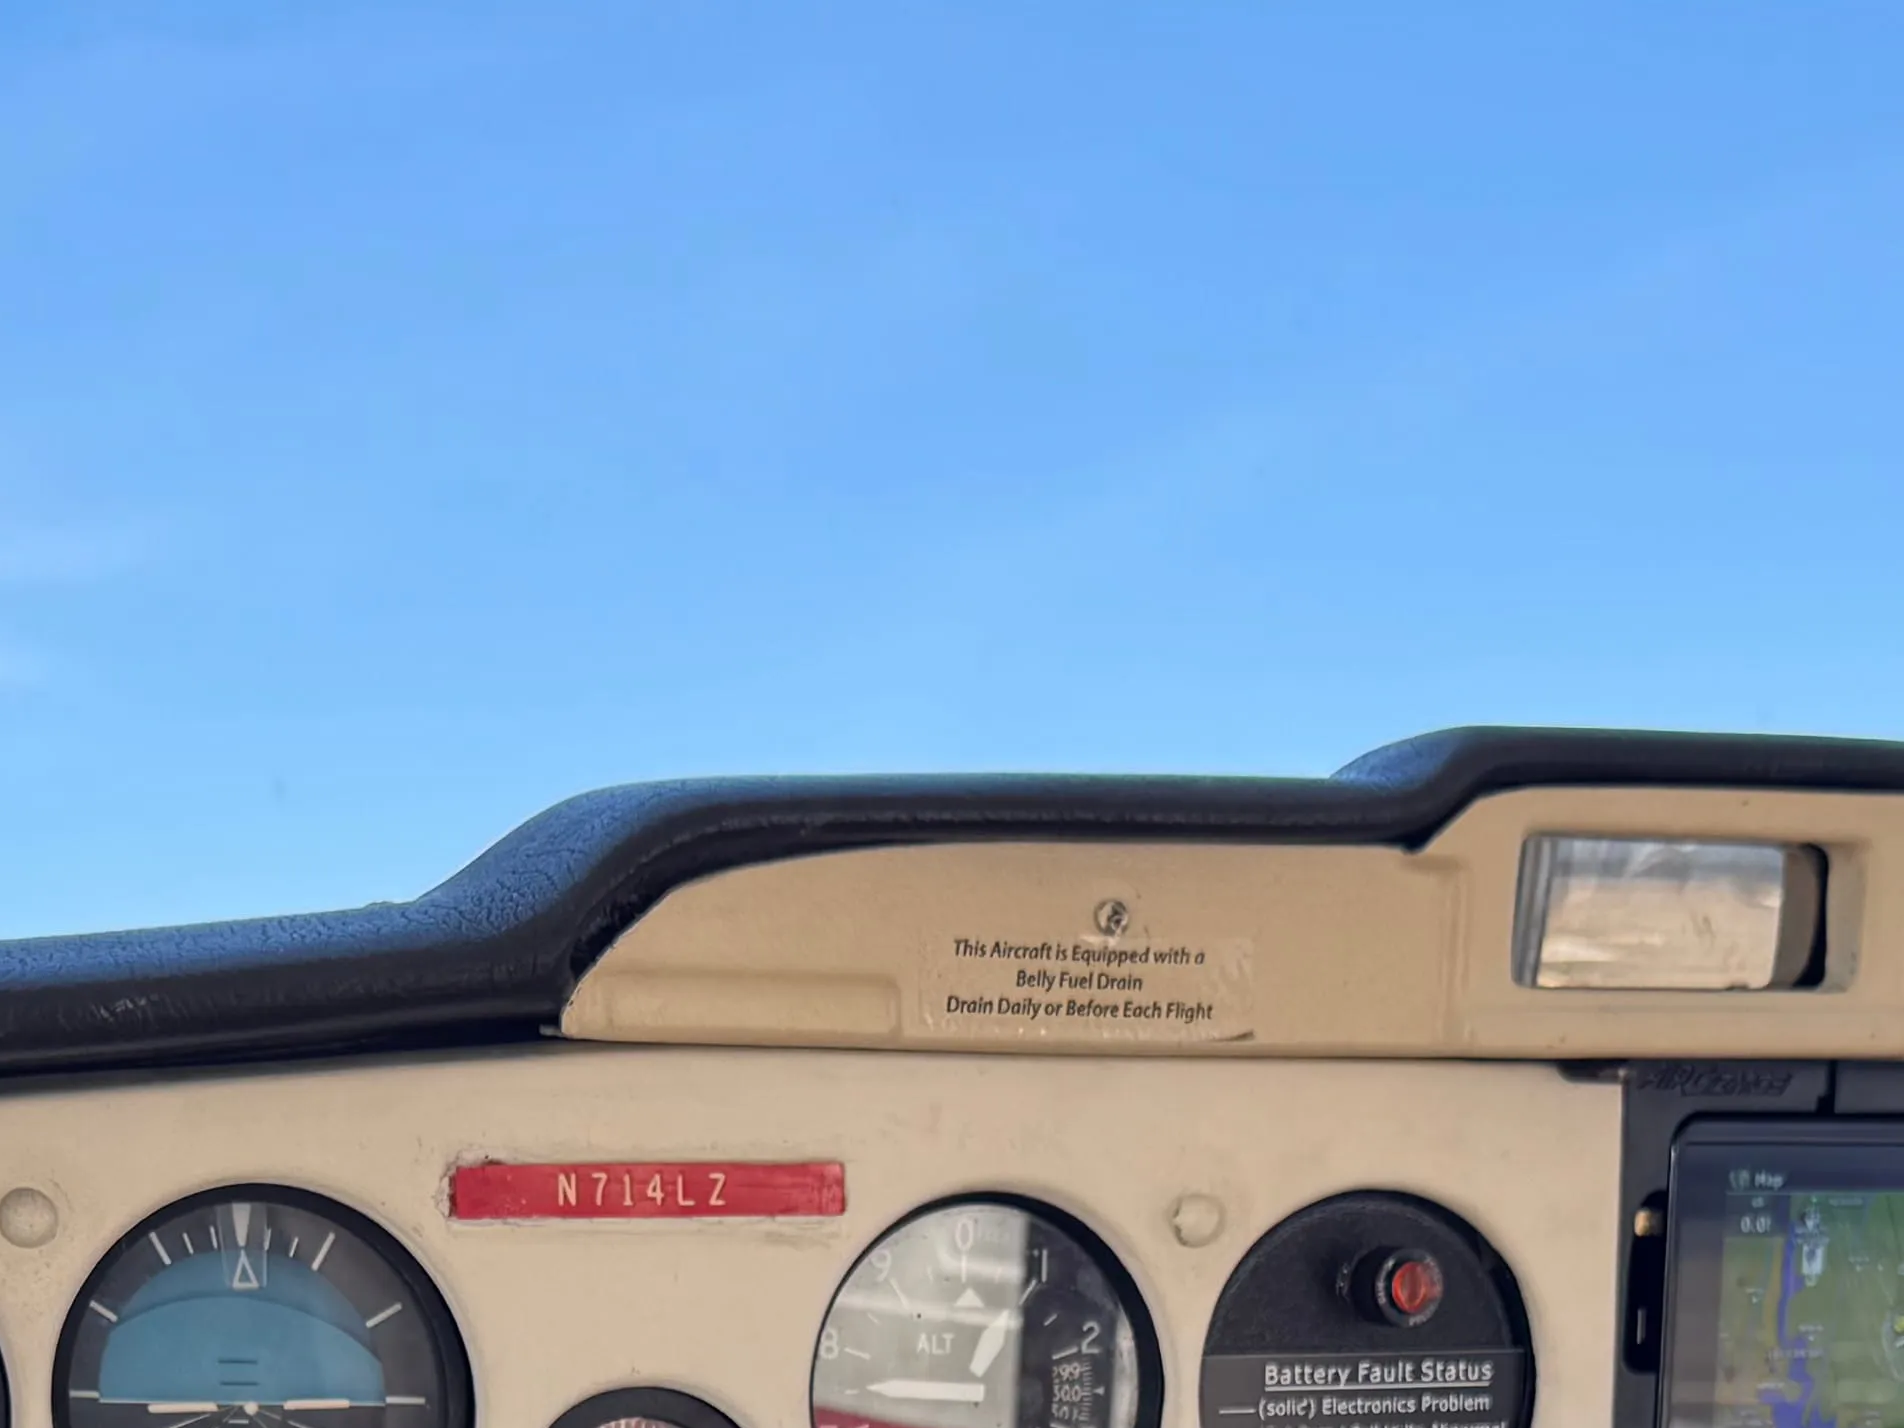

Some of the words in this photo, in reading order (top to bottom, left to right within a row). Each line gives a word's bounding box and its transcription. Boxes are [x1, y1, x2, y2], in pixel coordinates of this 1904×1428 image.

[953, 939, 986, 957] This
[990, 941, 1054, 960] Aircraft
[1056, 946, 1067, 961] is
[1071, 945, 1149, 967] Equipped
[1153, 948, 1189, 964] with
[1194, 952, 1205, 964] a
[1016, 970, 1056, 992] Belly
[1059, 972, 1093, 990] Fuel
[1097, 973, 1142, 991] Drain
[946, 995, 993, 1014] Drain
[997, 998, 1041, 1020] Daily
[1045, 1004, 1062, 1016] or
[1066, 1000, 1118, 1018] Before
[1123, 1001, 1161, 1019] Each
[1166, 1002, 1213, 1024] Flight
[558, 1172, 726, 1206] N714LZ
[917, 1334, 954, 1355] ALT
[1264, 1363, 1351, 1388] Battery
[1357, 1362, 1414, 1384] Fault
[1420, 1360, 1494, 1382] Status
[1322, 1397, 1416, 1417] Electronics
[1421, 1394, 1490, 1413] Problem
